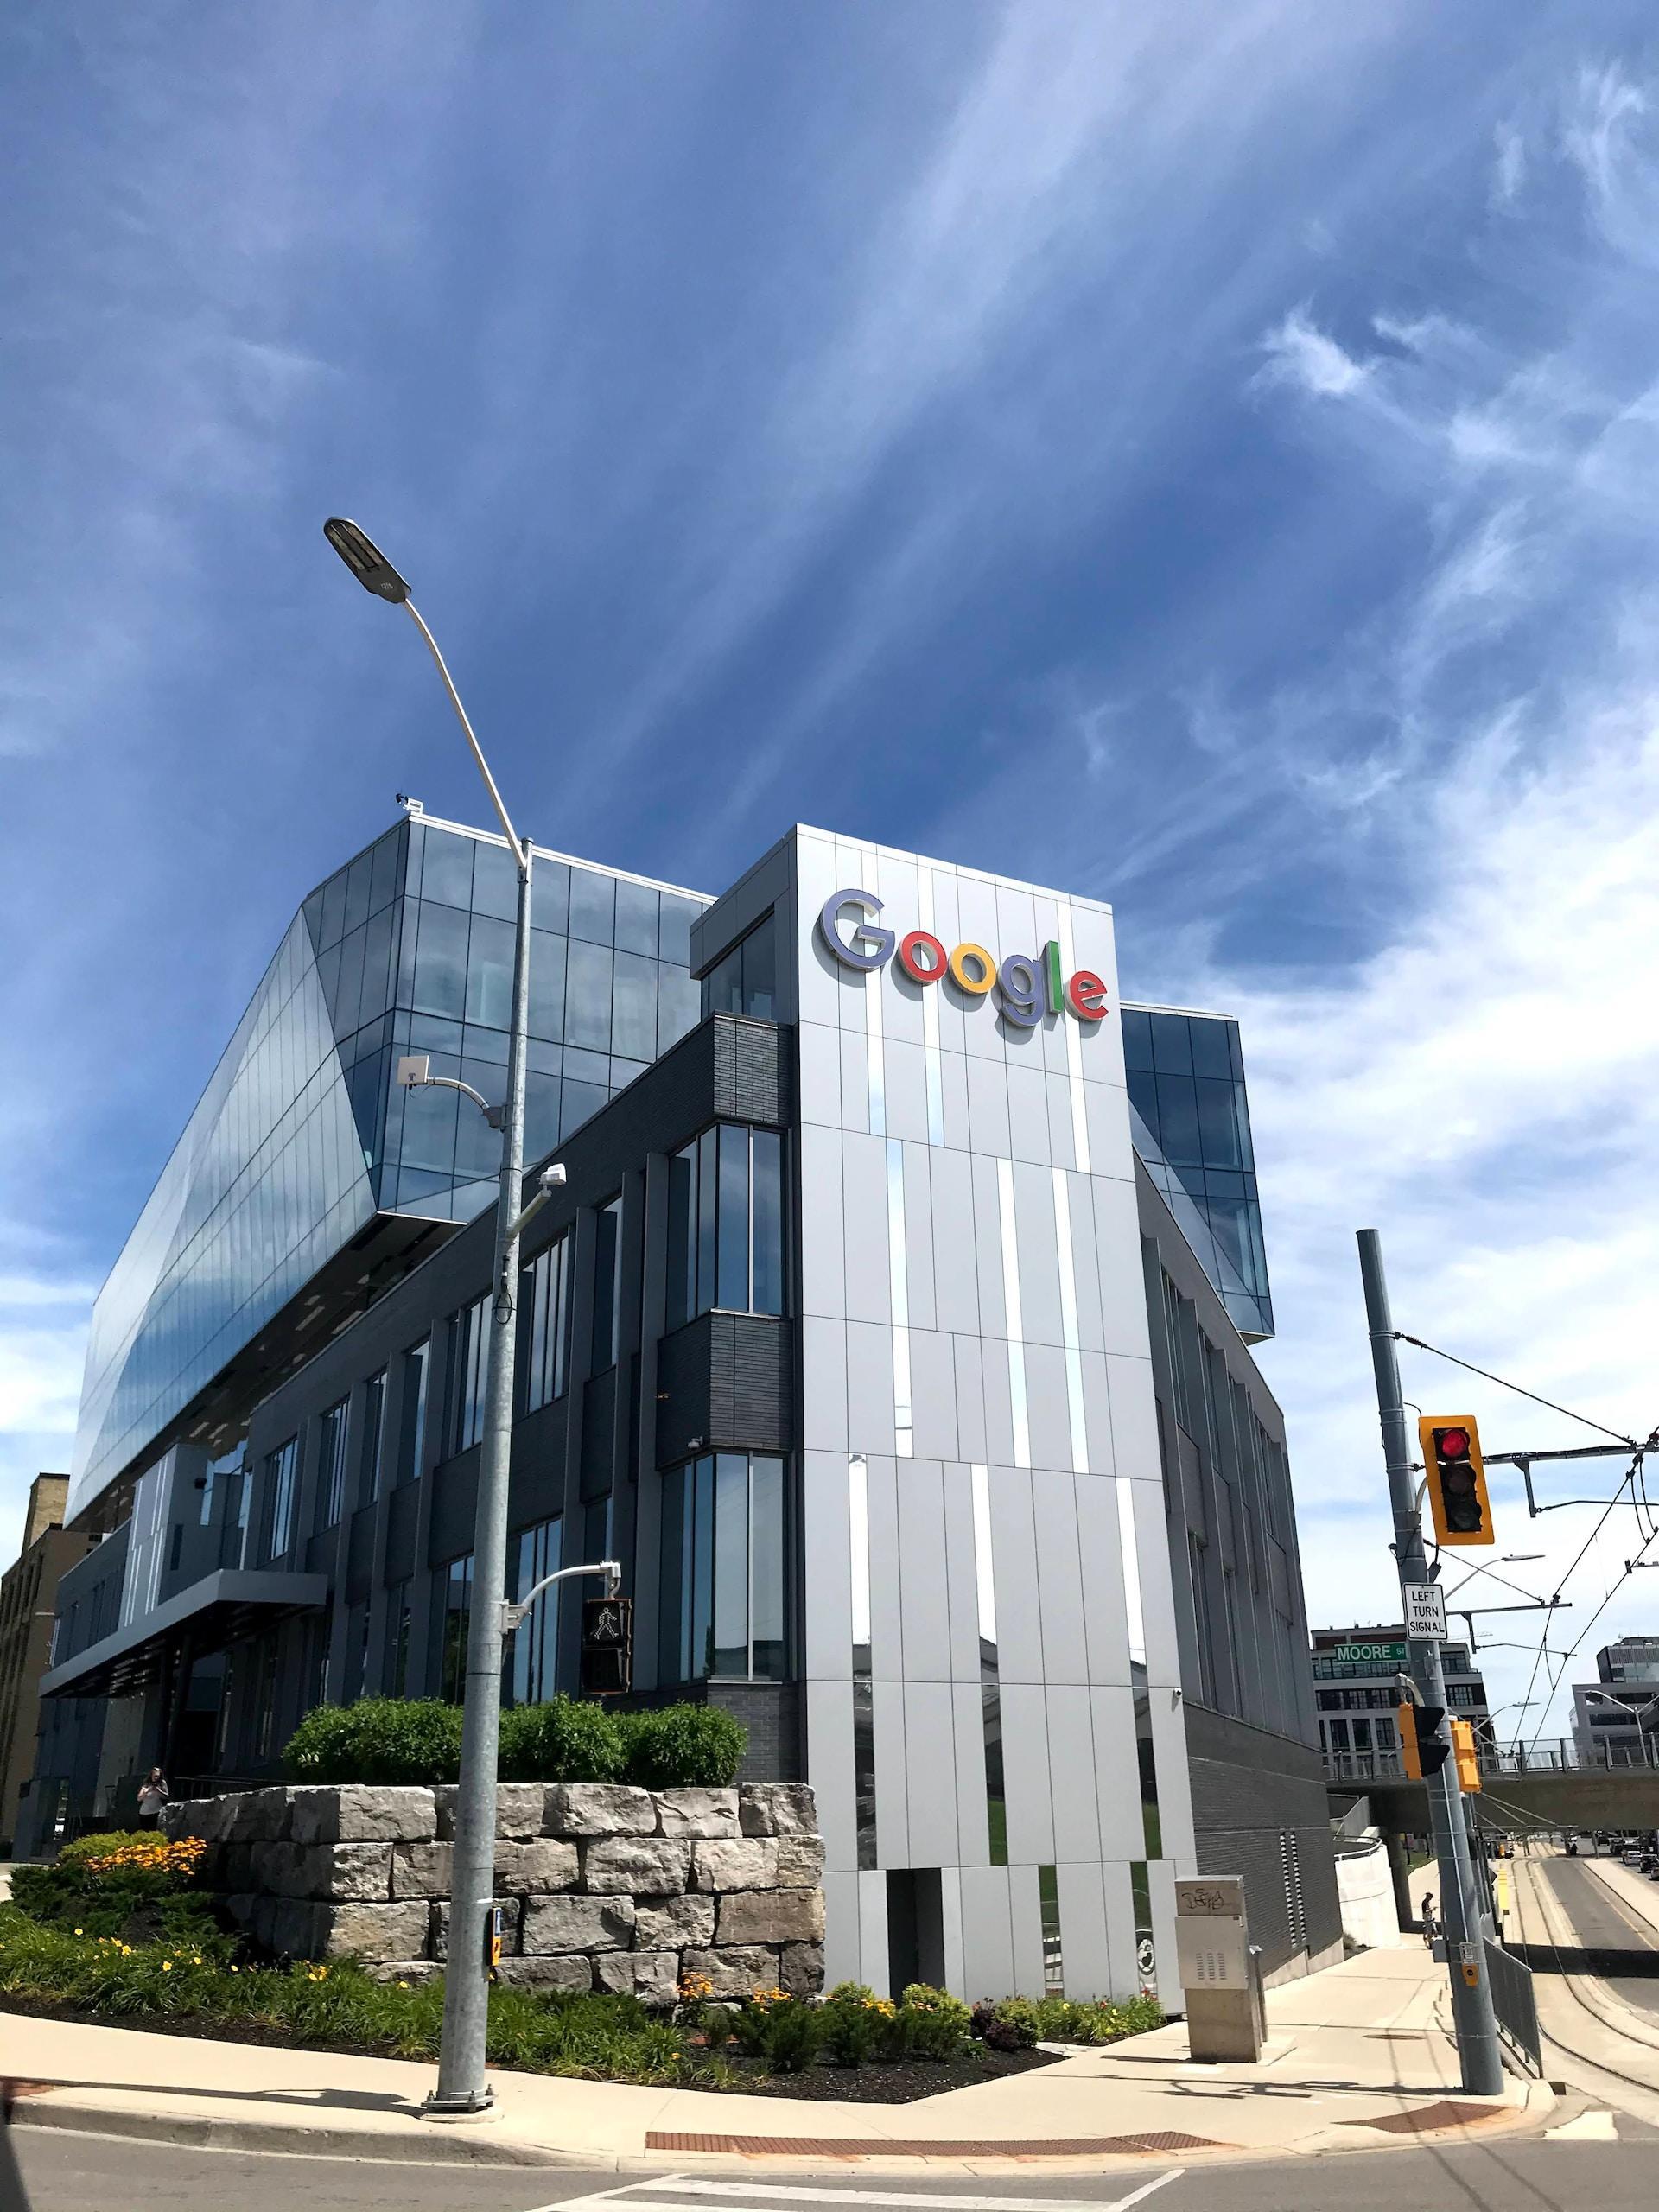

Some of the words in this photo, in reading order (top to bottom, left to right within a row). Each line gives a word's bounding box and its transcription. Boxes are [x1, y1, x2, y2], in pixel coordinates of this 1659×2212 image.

[822, 888, 1109, 1027] Google
[1411, 1591, 1435, 1602] LEFT
[1413, 1605, 1439, 1617] TURN
[1409, 1621, 1445, 1632] SIGNAL
[1337, 1645, 1391, 1660] MOORE
